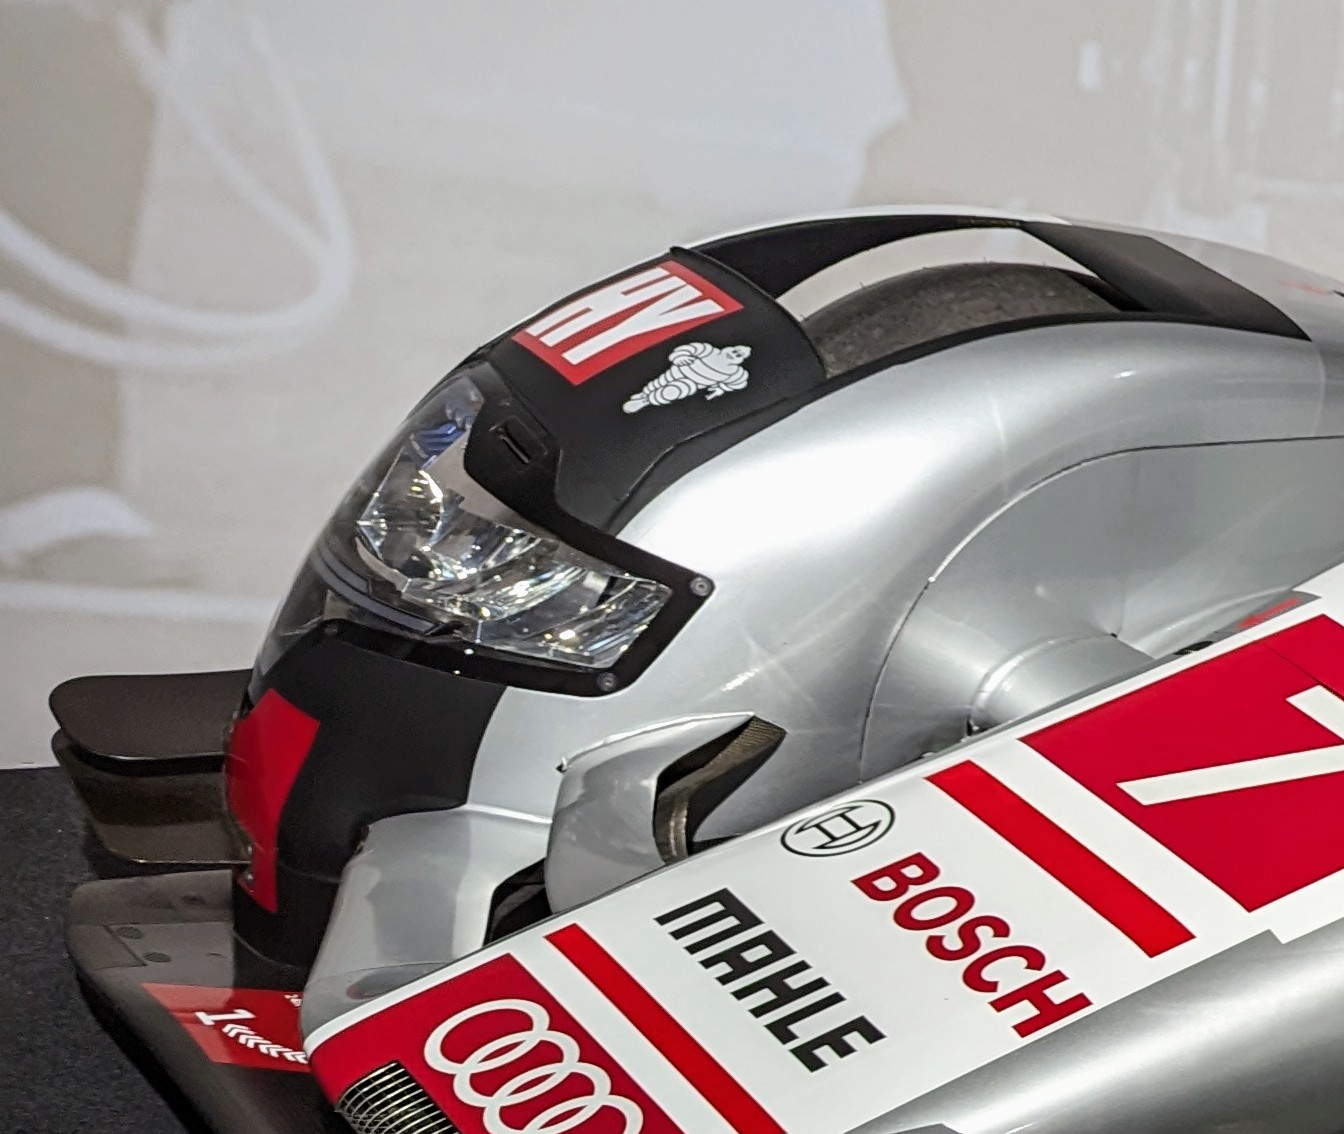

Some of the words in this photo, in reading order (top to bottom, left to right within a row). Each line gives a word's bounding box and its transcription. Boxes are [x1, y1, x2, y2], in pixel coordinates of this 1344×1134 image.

[525, 267, 726, 366] HY
[653, 887, 887, 1073] MAHLE
[850, 852, 1094, 1039] BOSCH
